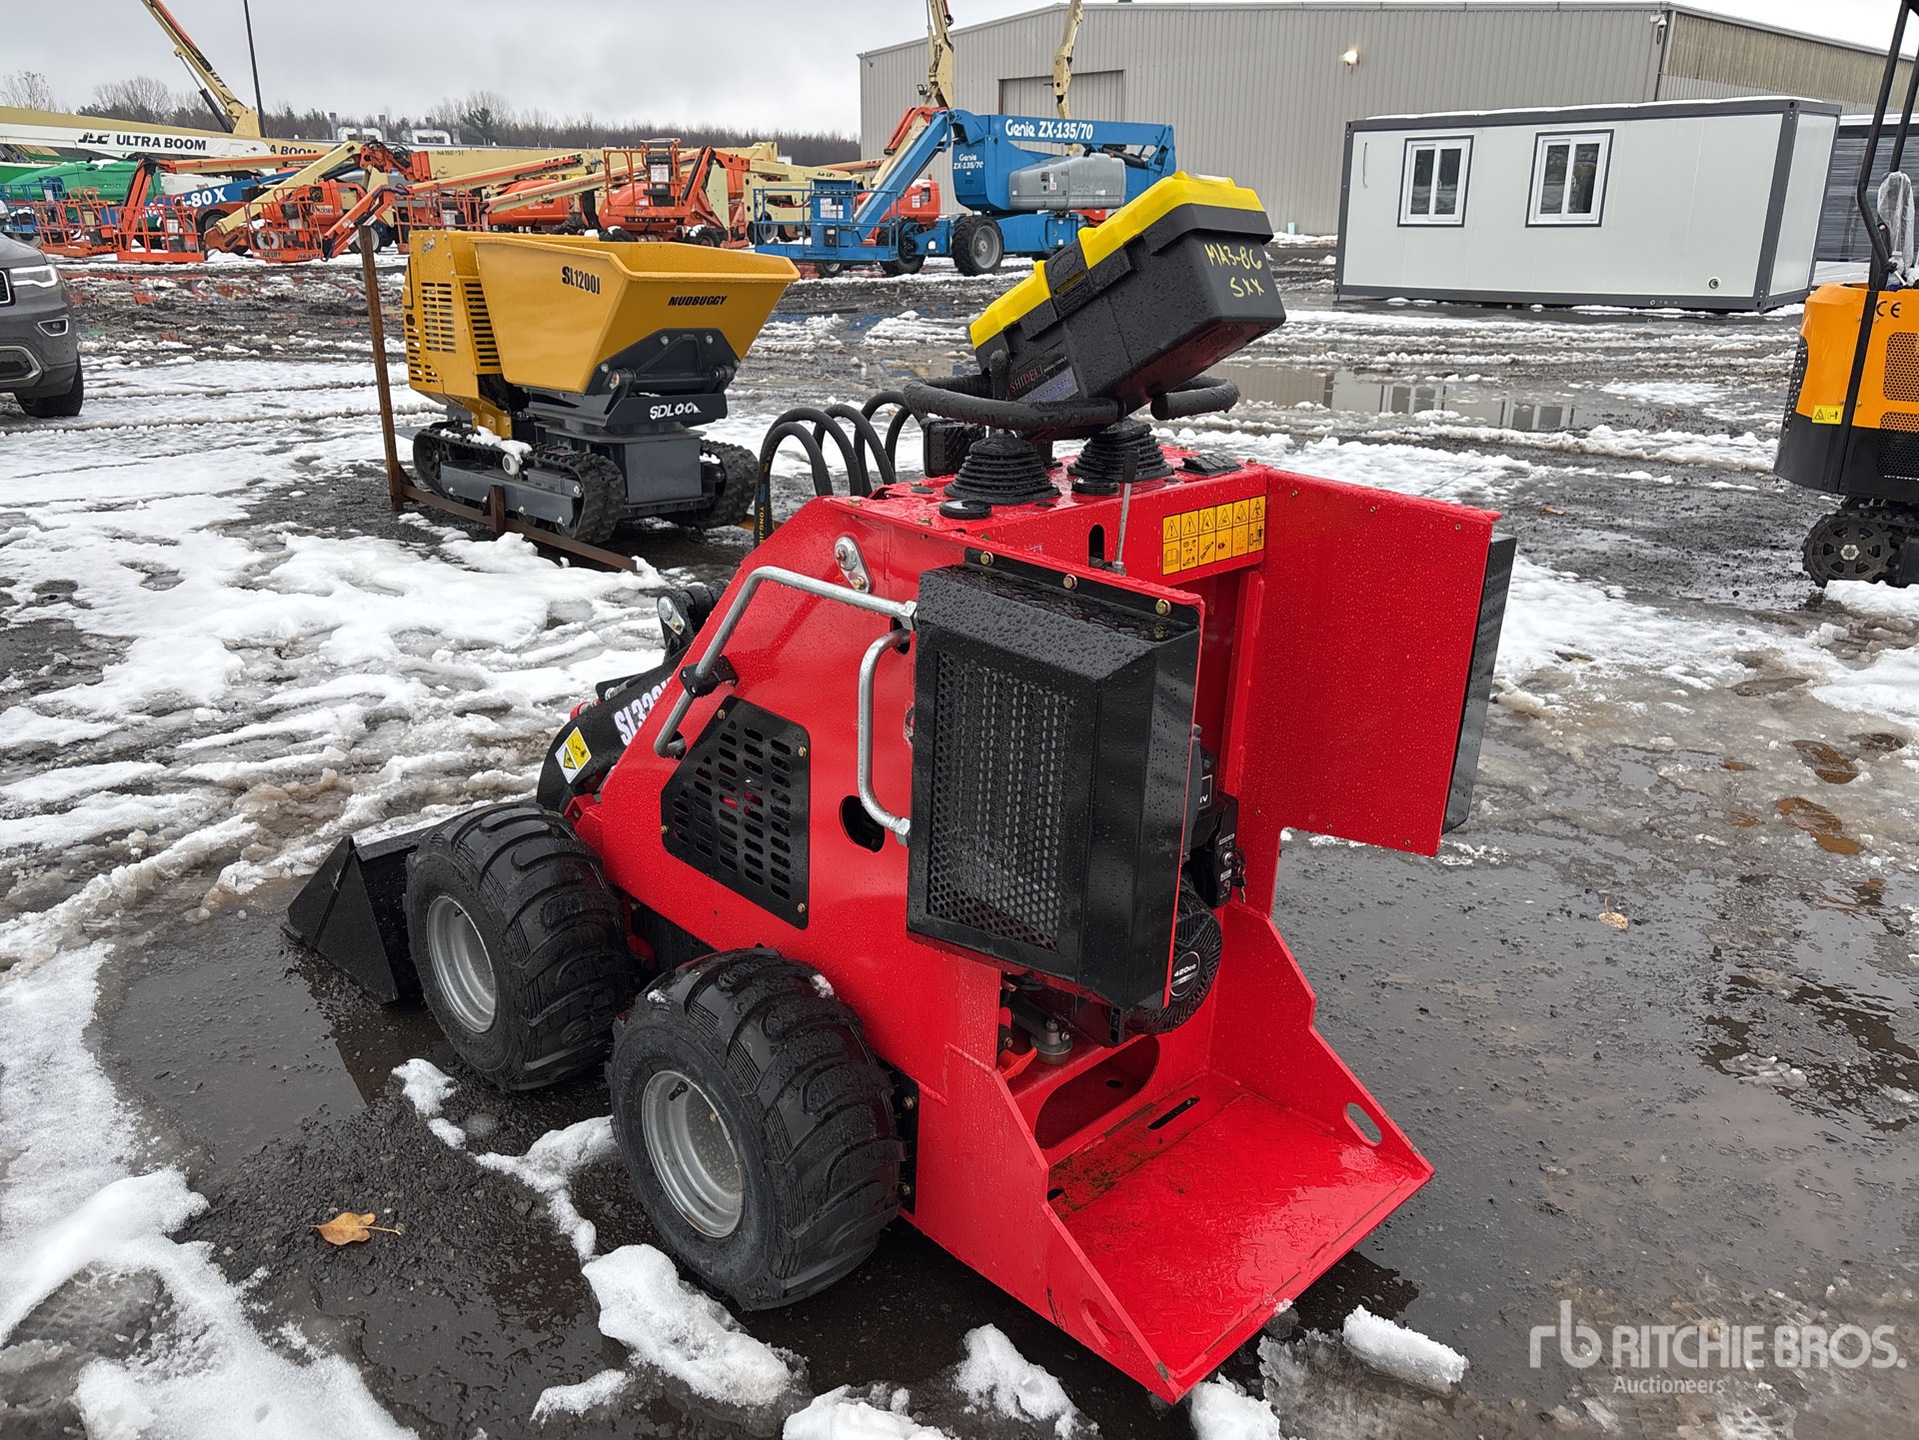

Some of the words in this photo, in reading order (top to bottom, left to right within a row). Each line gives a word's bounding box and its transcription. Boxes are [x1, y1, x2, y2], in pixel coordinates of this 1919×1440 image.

[1005, 118, 1036, 137] Genie
[1037, 120, 1094, 140] ZX-135/70
[116, 134, 161, 148] ULTRA
[163, 137, 206, 151] BOOM
[1203, 243, 1263, 270] MA3-86
[667, 295, 728, 307] MUDBUGGY
